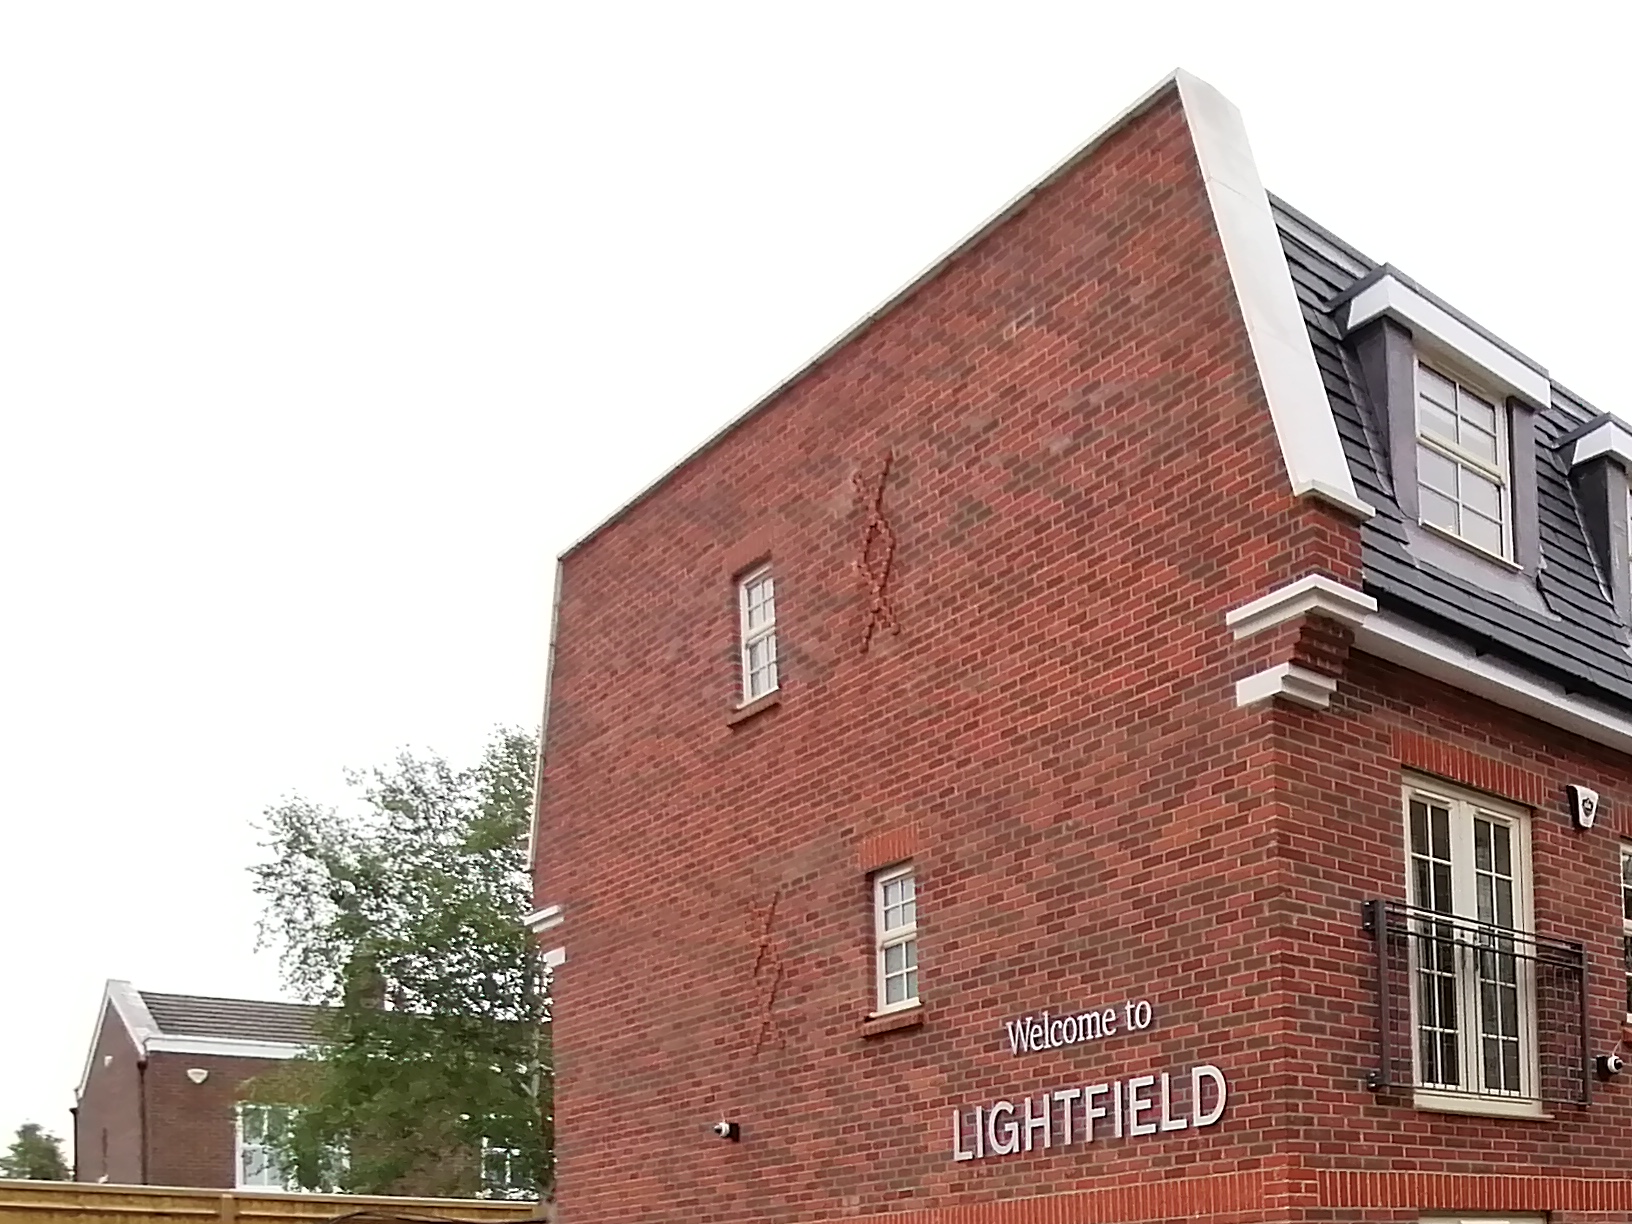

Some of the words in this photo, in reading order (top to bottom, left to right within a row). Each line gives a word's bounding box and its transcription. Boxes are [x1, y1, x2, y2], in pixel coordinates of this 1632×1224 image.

[1006, 1009, 1117, 1056] Welcome
[1125, 1000, 1152, 1031] to
[953, 1064, 1228, 1162] LIGHTFIELD
